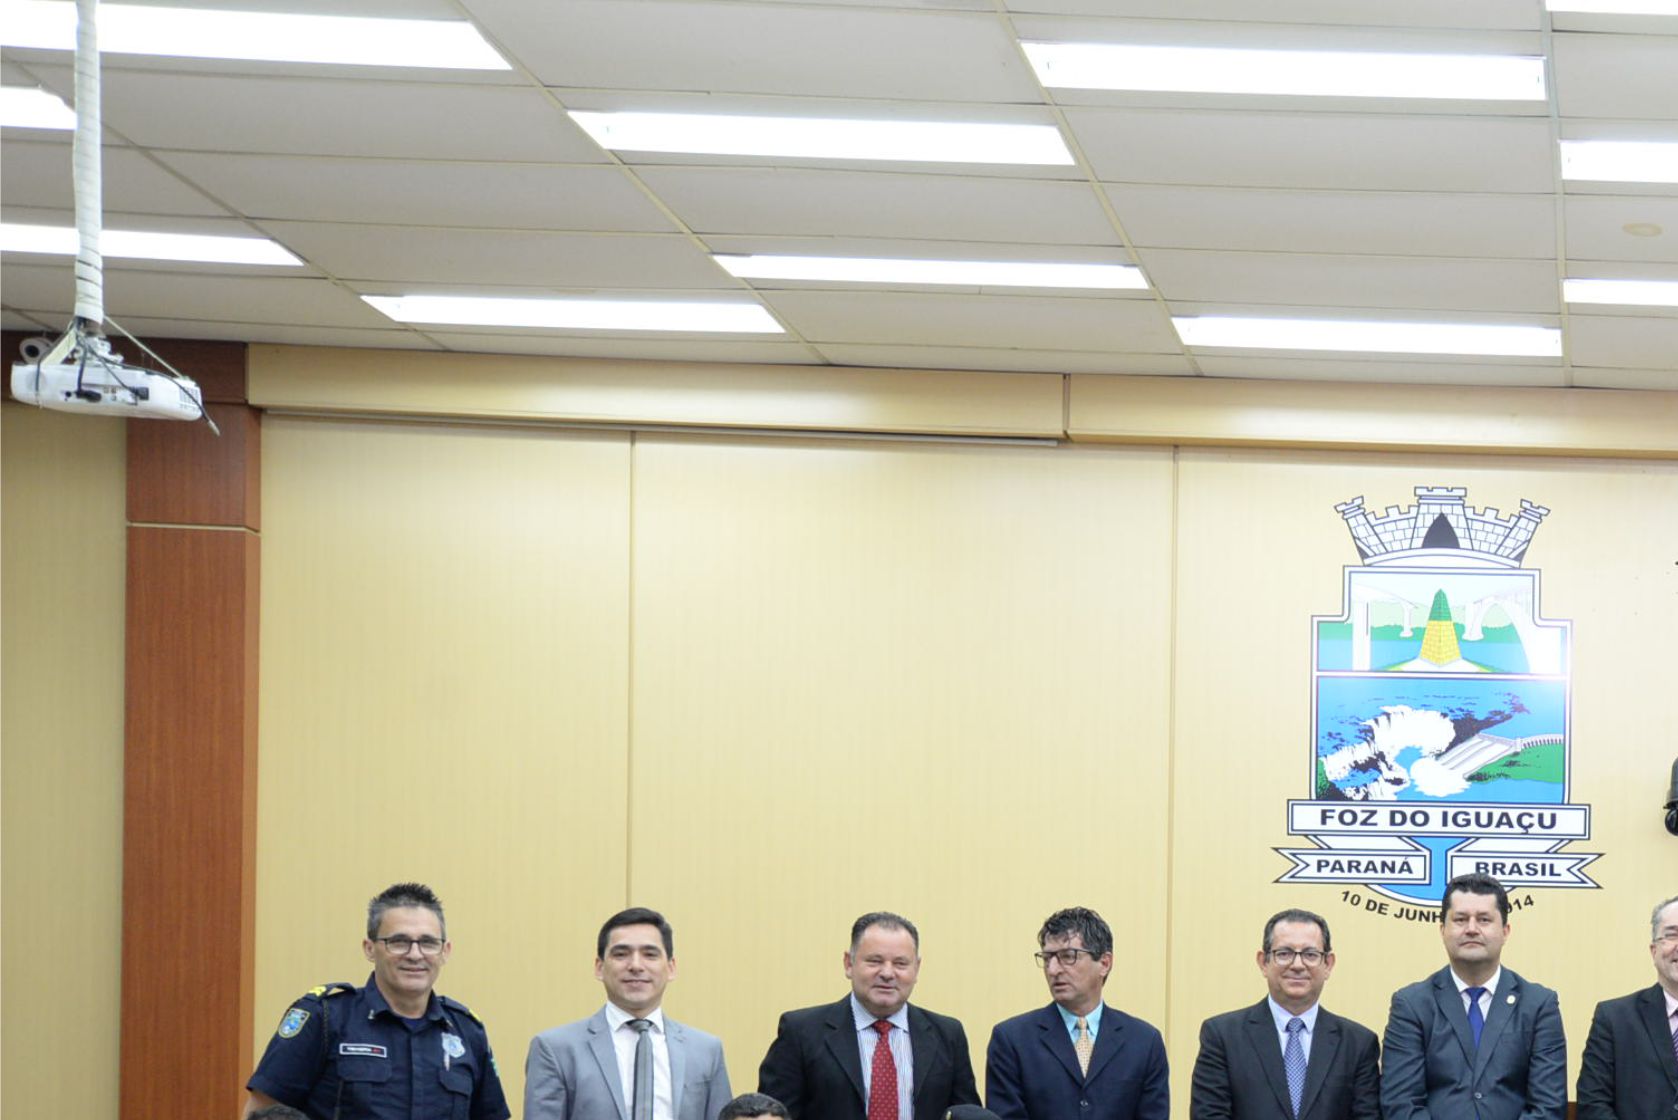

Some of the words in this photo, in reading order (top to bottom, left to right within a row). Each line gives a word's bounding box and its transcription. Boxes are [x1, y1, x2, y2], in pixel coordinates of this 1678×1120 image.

[1320, 808, 1378, 827] FOZ
[1389, 810, 1430, 828] DO
[1442, 811, 1557, 835] IGUAÇU
[1316, 856, 1413, 875] PARANÁ
[1475, 862, 1561, 877] BRASIL
[1341, 890, 1361, 906] 10
[1365, 899, 1388, 916] DE
[1394, 907, 1443, 923] JUNH
